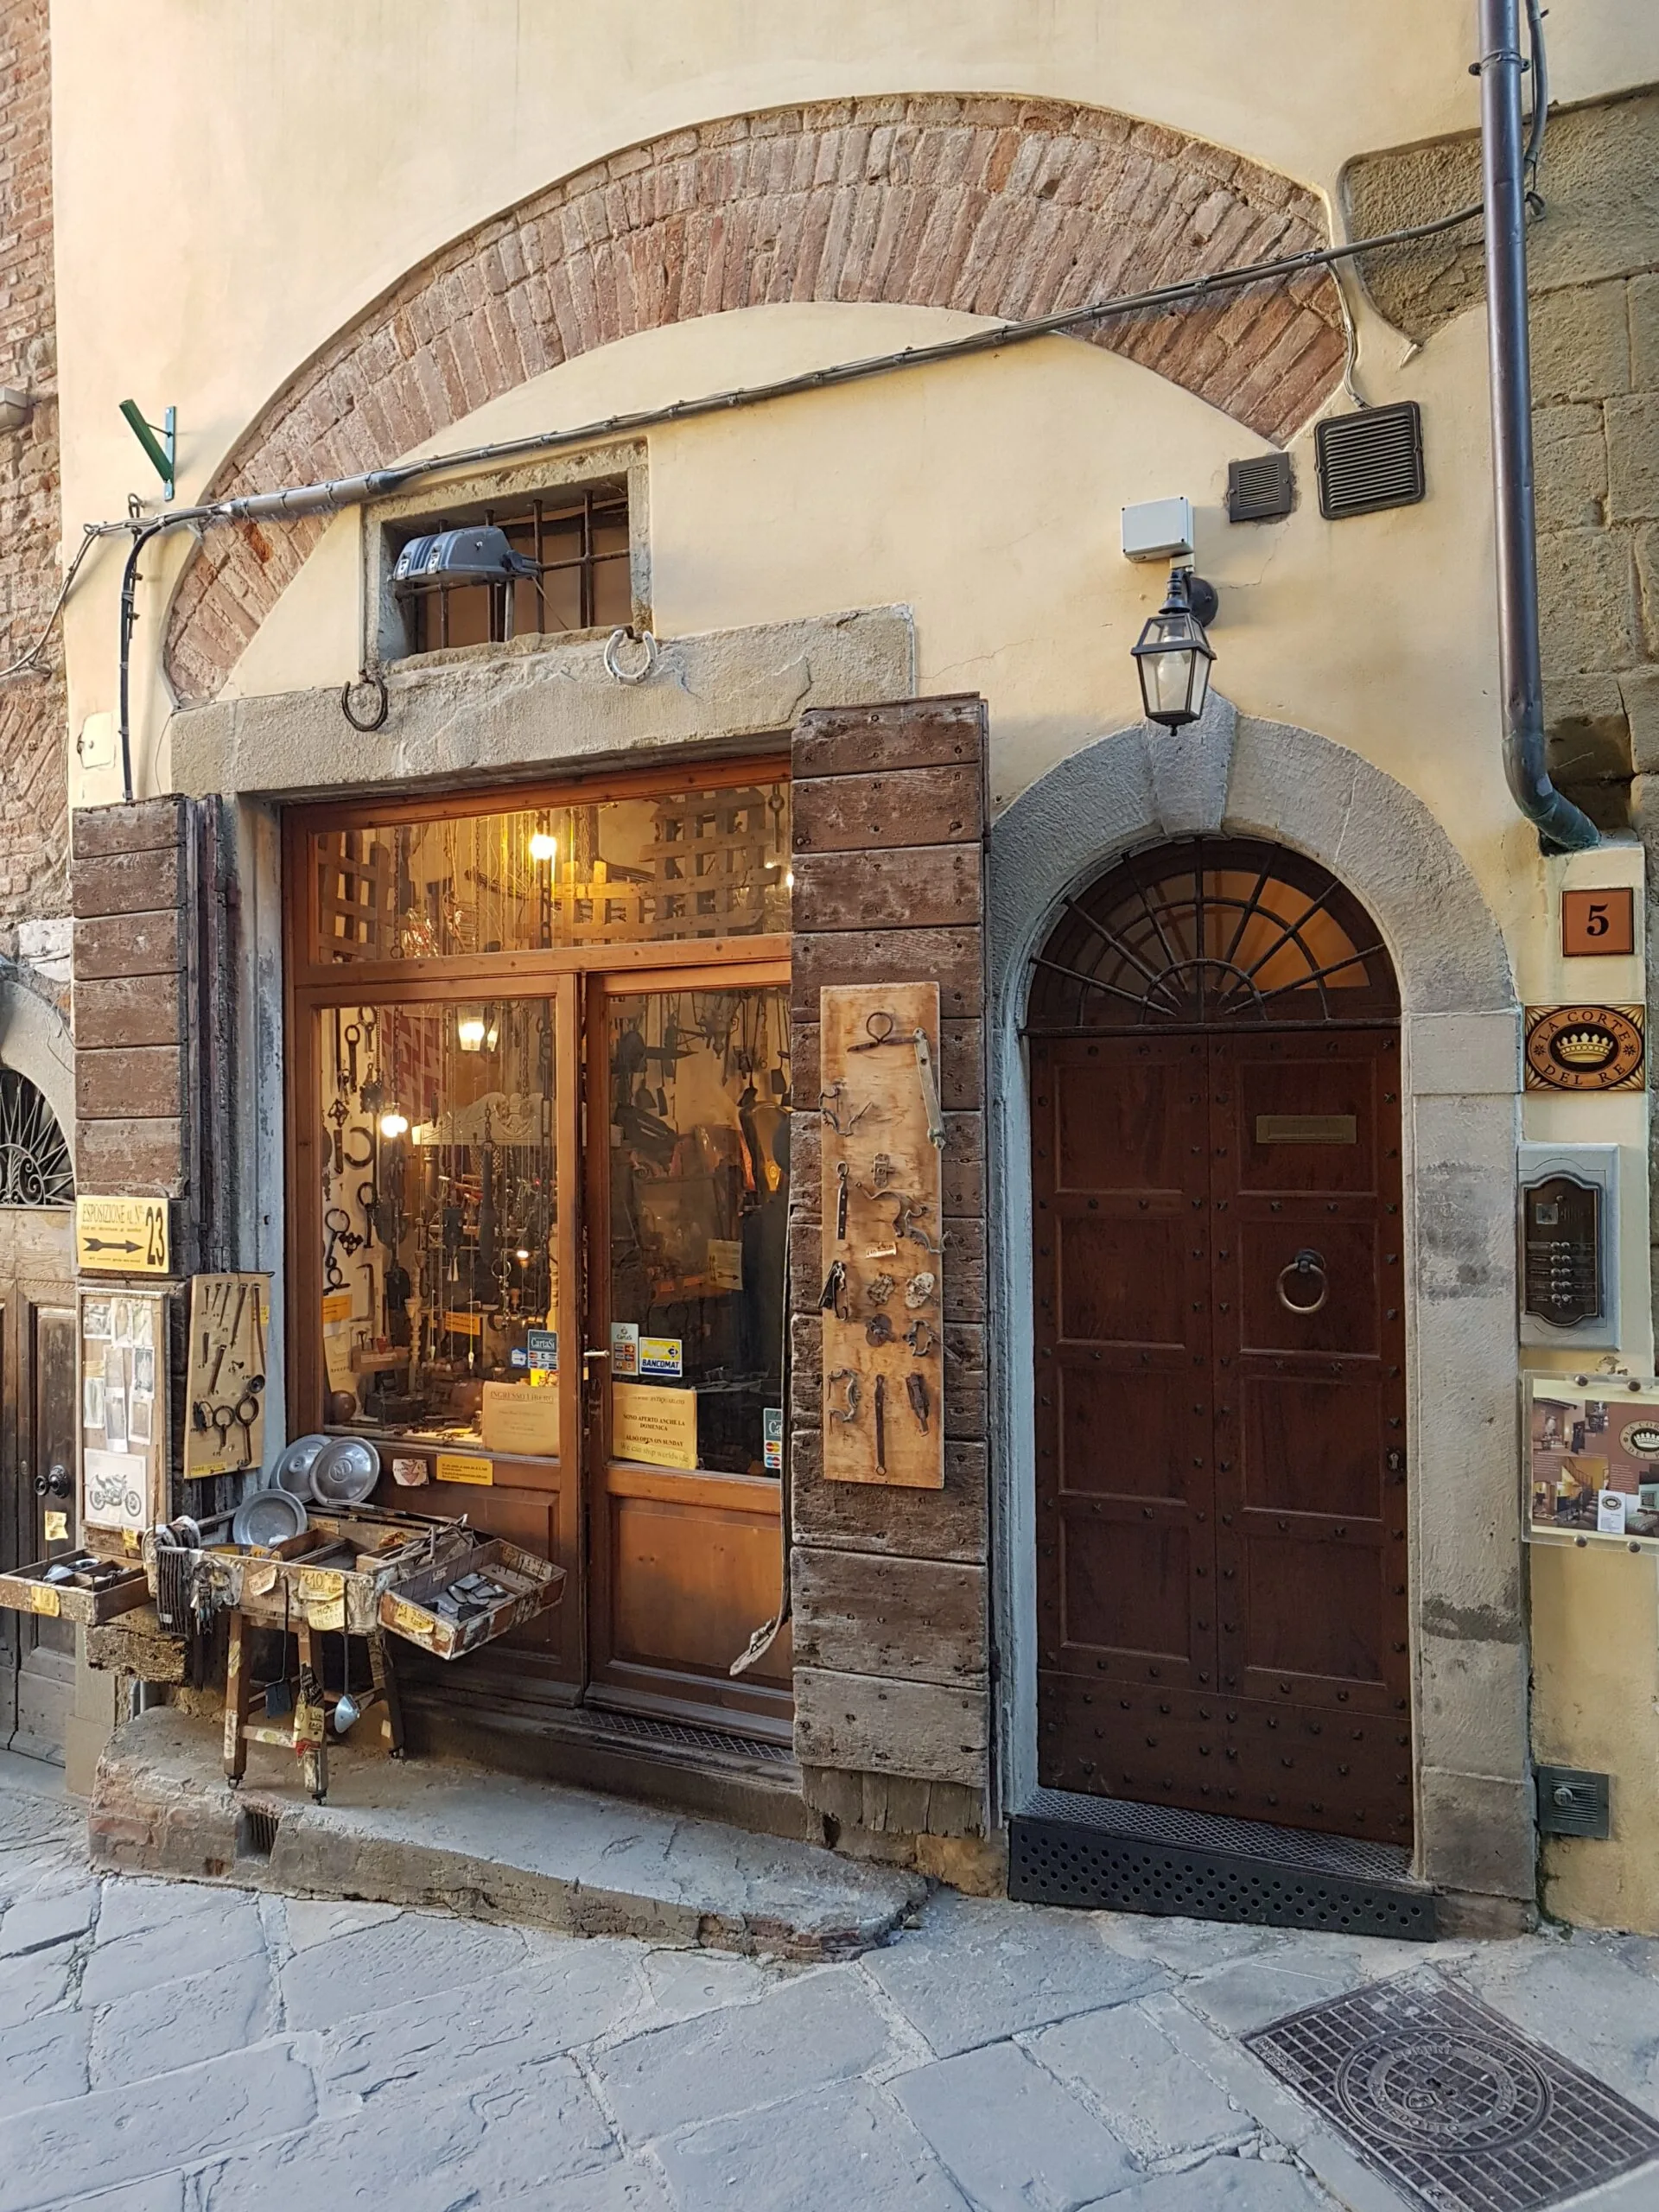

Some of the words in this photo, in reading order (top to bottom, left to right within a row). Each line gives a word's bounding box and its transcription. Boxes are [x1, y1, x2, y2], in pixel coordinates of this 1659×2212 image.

[1586, 903, 1609, 936] 5
[1539, 1021, 1559, 1041] LA
[1567, 1011, 1630, 1042] CORTE
[1543, 1064, 1583, 1085] DEL
[1599, 1064, 1625, 1084] RE
[82, 1204, 125, 1224] ESPOSIZIONE
[146, 1206, 165, 1267] 23
[642, 1359, 680, 1369] BANCOMAT
[639, 1422, 668, 1432] DOMENICA
[643, 1447, 657, 1457] ship
